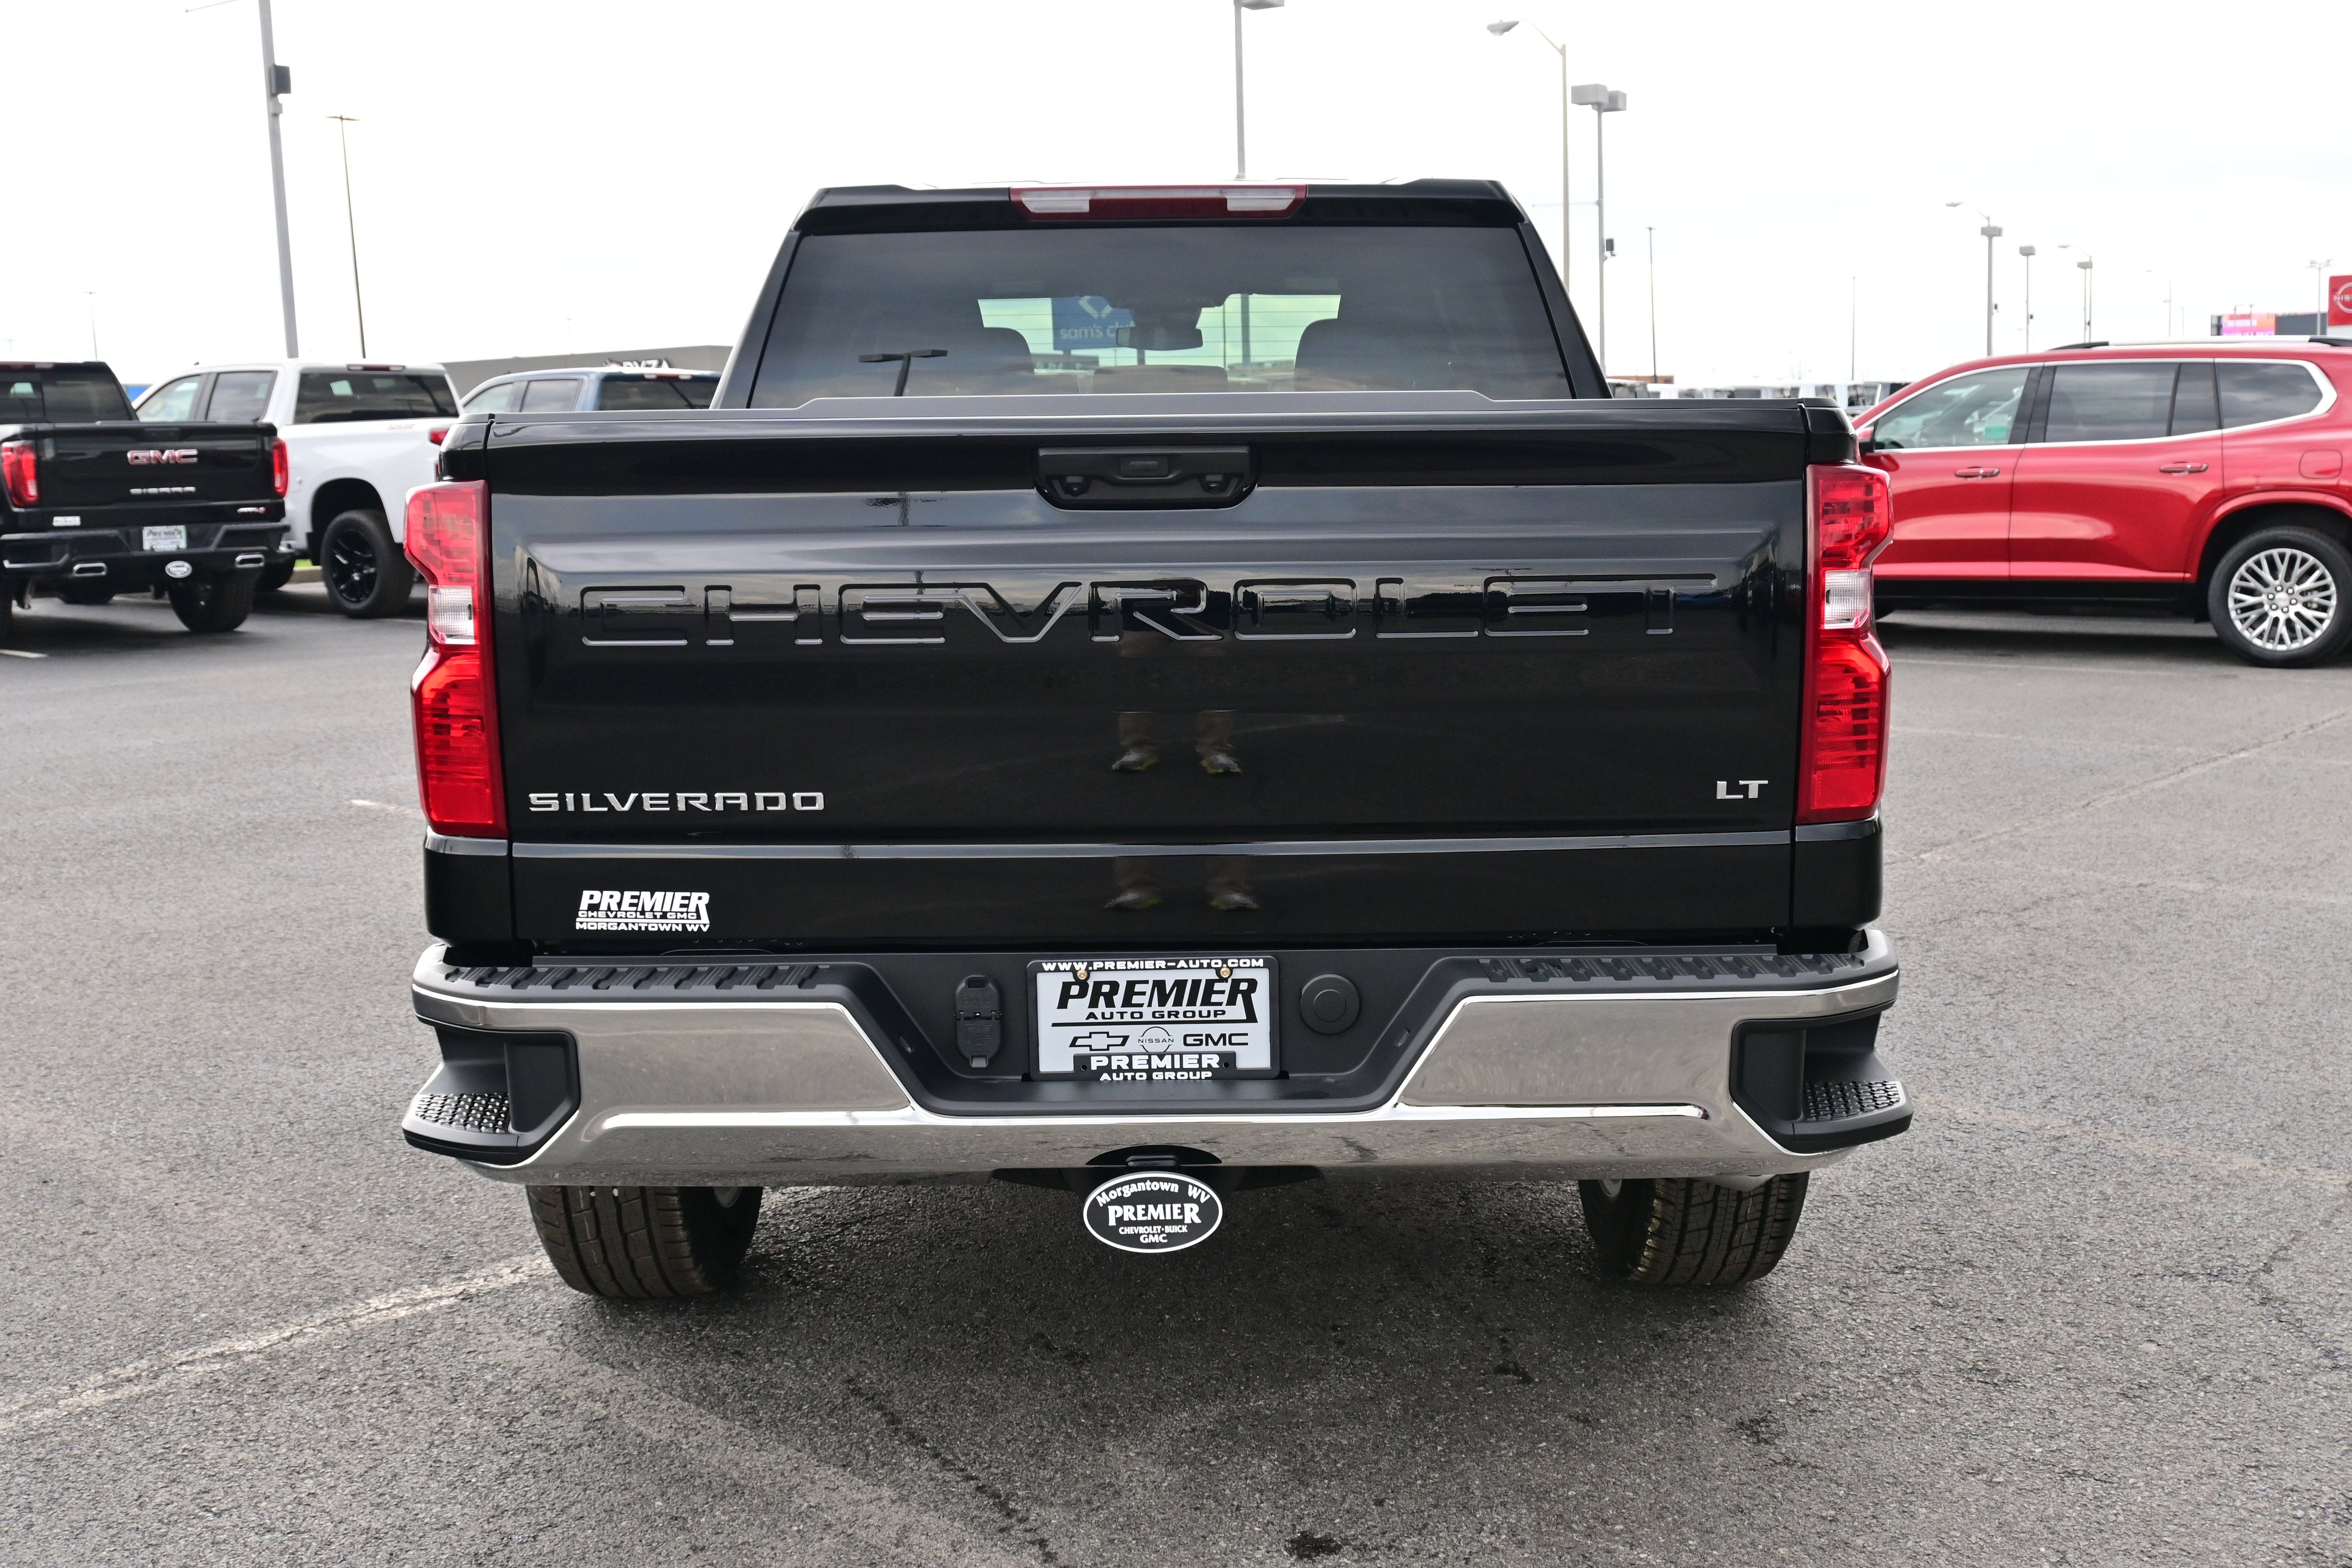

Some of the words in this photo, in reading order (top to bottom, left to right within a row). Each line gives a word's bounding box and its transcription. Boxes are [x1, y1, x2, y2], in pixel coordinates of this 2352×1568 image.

[1059, 324, 1103, 340] sam's
[127, 449, 199, 465] GMC
[580, 573, 1717, 646] CHEVROLET
[1716, 780, 1769, 799] LT
[528, 792, 824, 811] SILVERADO
[578, 911, 663, 919] CHEVROLET
[579, 890, 710, 924] PREMIER
[575, 922, 683, 931] MORGANTOWN
[1042, 959, 1264, 971] WWW.PREMIER-AUTO.COM
[1056, 978, 1258, 1023] PREMIER
[1085, 1011, 1143, 1021] AUTO
[1152, 1009, 1226, 1019] GROUP
[1183, 1033, 1249, 1047] GMC
[1091, 1054, 1220, 1070] PREMIER
[1100, 1072, 1147, 1081] AUTO
[1152, 1071, 1212, 1081] GROUP
[1096, 1179, 1179, 1207] Morgantown
[1187, 1184, 1211, 1203] WV
[1107, 1203, 1202, 1226] PREMIER
[1140, 1234, 1168, 1243] GMC
